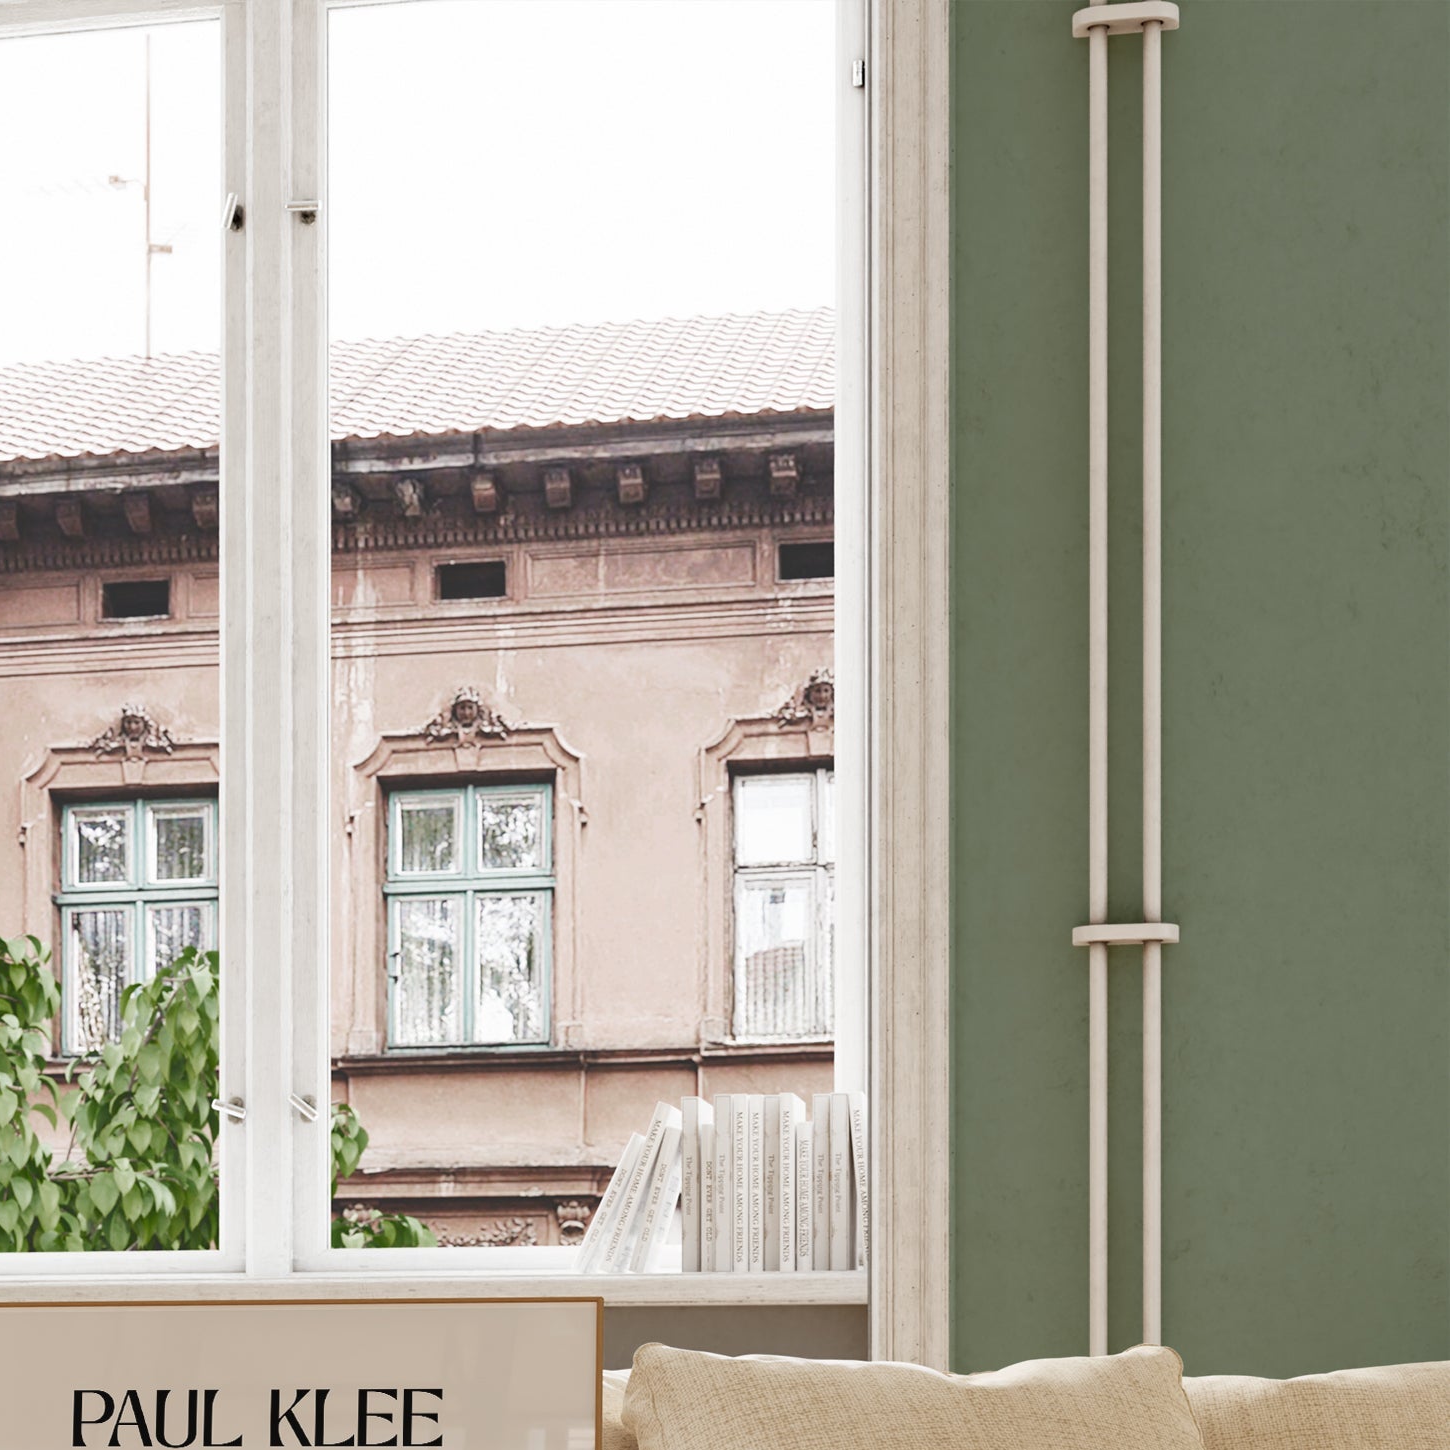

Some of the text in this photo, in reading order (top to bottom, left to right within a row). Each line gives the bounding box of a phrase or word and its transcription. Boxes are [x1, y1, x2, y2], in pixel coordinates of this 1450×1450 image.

[853, 1109, 862, 1132] MAKE
[855, 1135, 864, 1161] YOUR
[736, 1111, 744, 1263] MAKE YOUR HOME AMONG FRIENDS
[752, 1112, 760, 1263] MAKE YOUR HOME AMONG FRIENDS
[782, 1110, 790, 1262] MAKE YOUR HOME AMONG FRIENDS
[857, 1161, 867, 1187] HOME
[72, 1388, 444, 1449] PAUL KLEE
